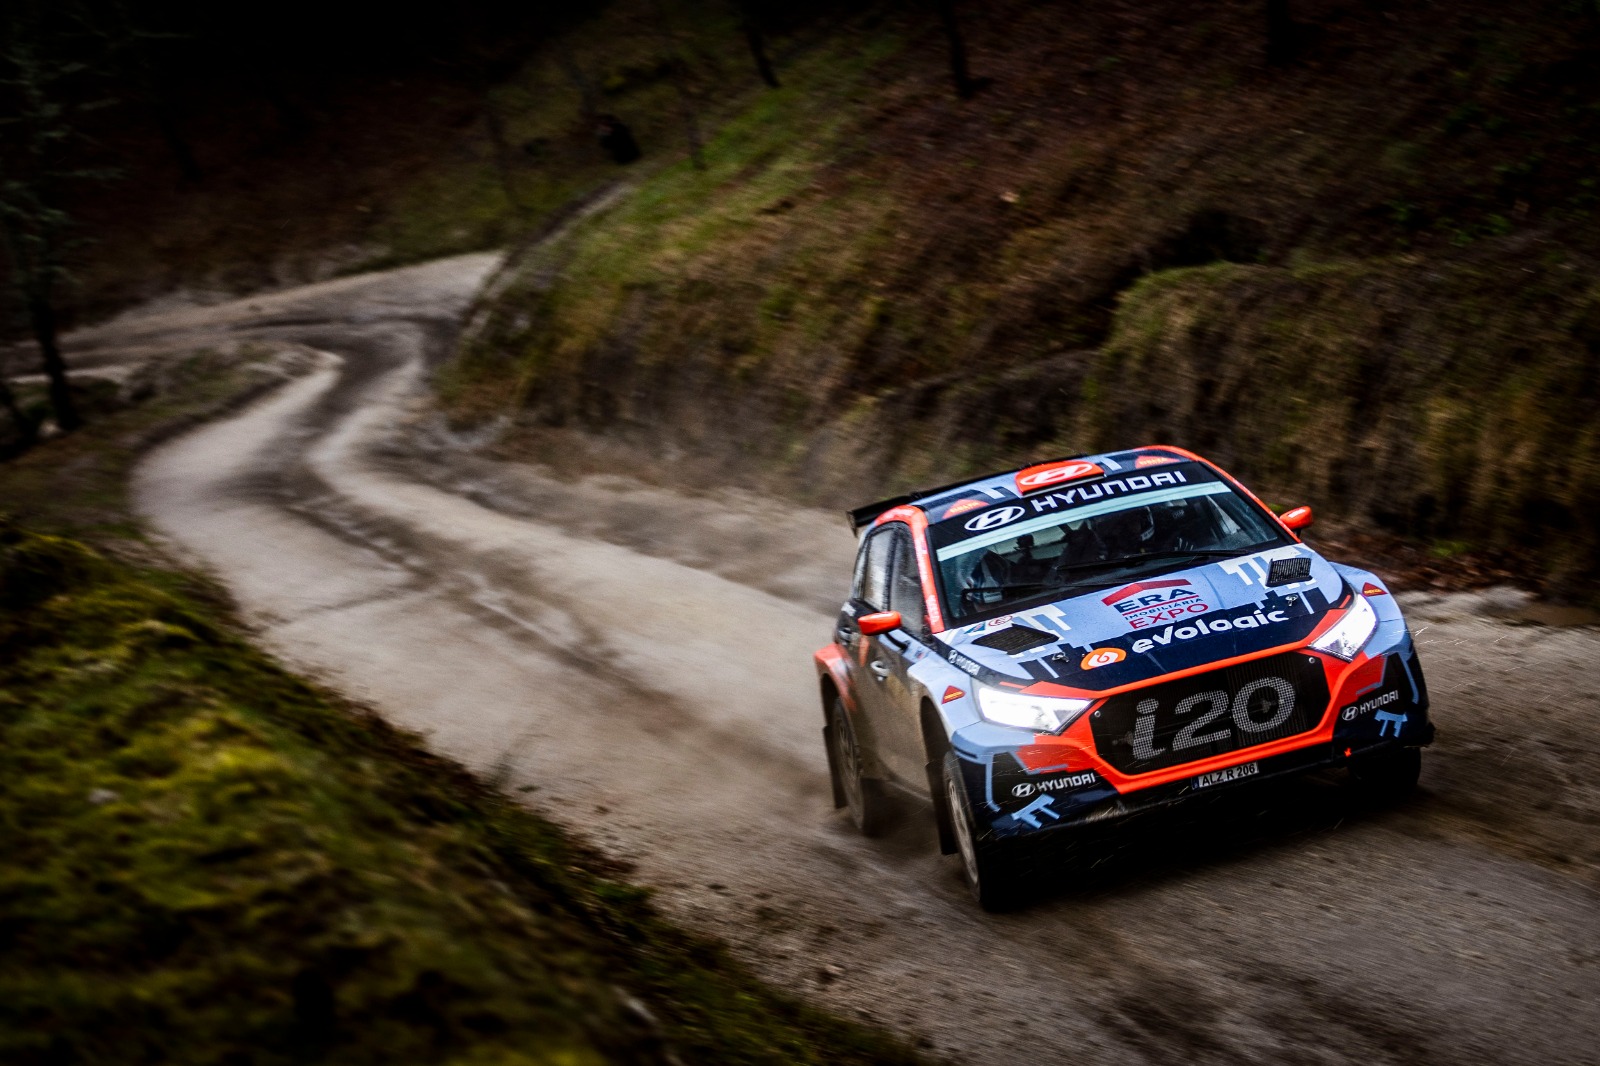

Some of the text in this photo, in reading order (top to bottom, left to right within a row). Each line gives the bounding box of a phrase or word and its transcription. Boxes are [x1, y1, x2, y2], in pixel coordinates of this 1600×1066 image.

[1031, 470, 1187, 512] HYUNDAI
[1113, 588, 1196, 613] ERA
[1129, 603, 1208, 629] EXPO
[1360, 690, 1399, 715] HYUNDAI
[1132, 676, 1296, 760] i20
[1036, 772, 1096, 792] HYUNDAI
[1202, 763, 1256, 787] ALZ R 206
